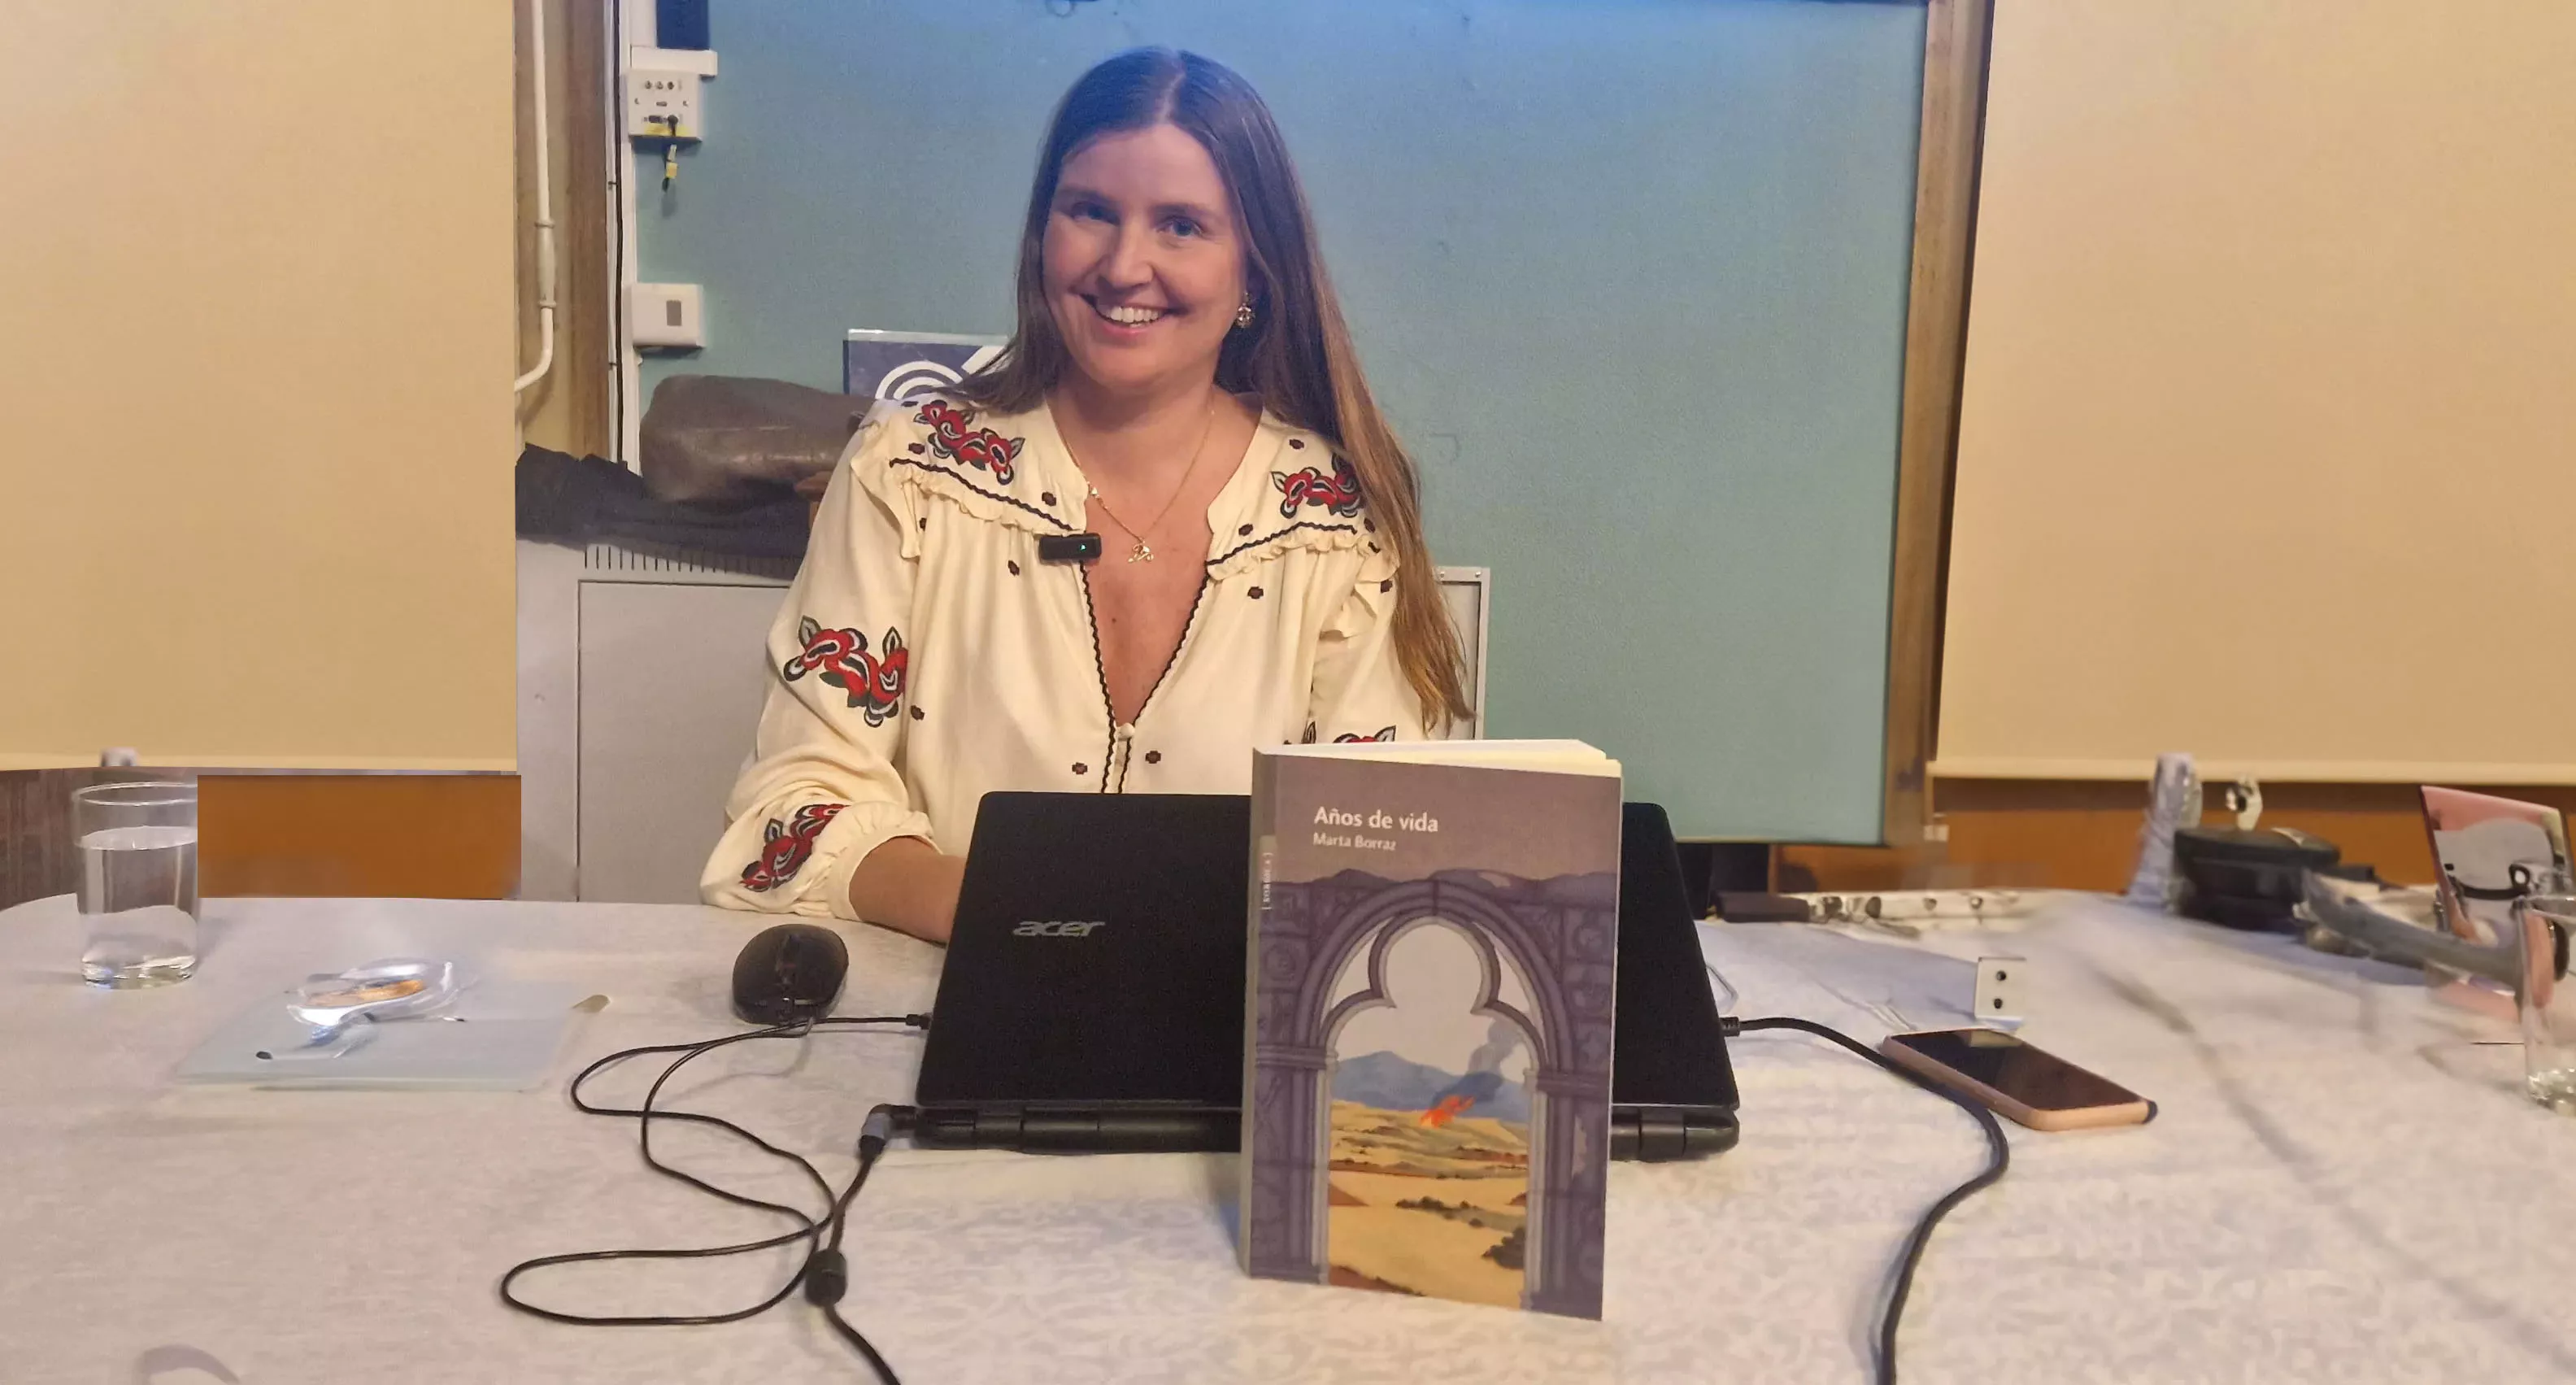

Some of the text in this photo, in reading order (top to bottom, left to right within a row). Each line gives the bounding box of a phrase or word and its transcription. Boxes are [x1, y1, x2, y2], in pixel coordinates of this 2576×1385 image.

[1314, 806, 1438, 832] Años de vida
[1313, 832, 1397, 851] Marta Borraz
[1012, 921, 1106, 937] acer
